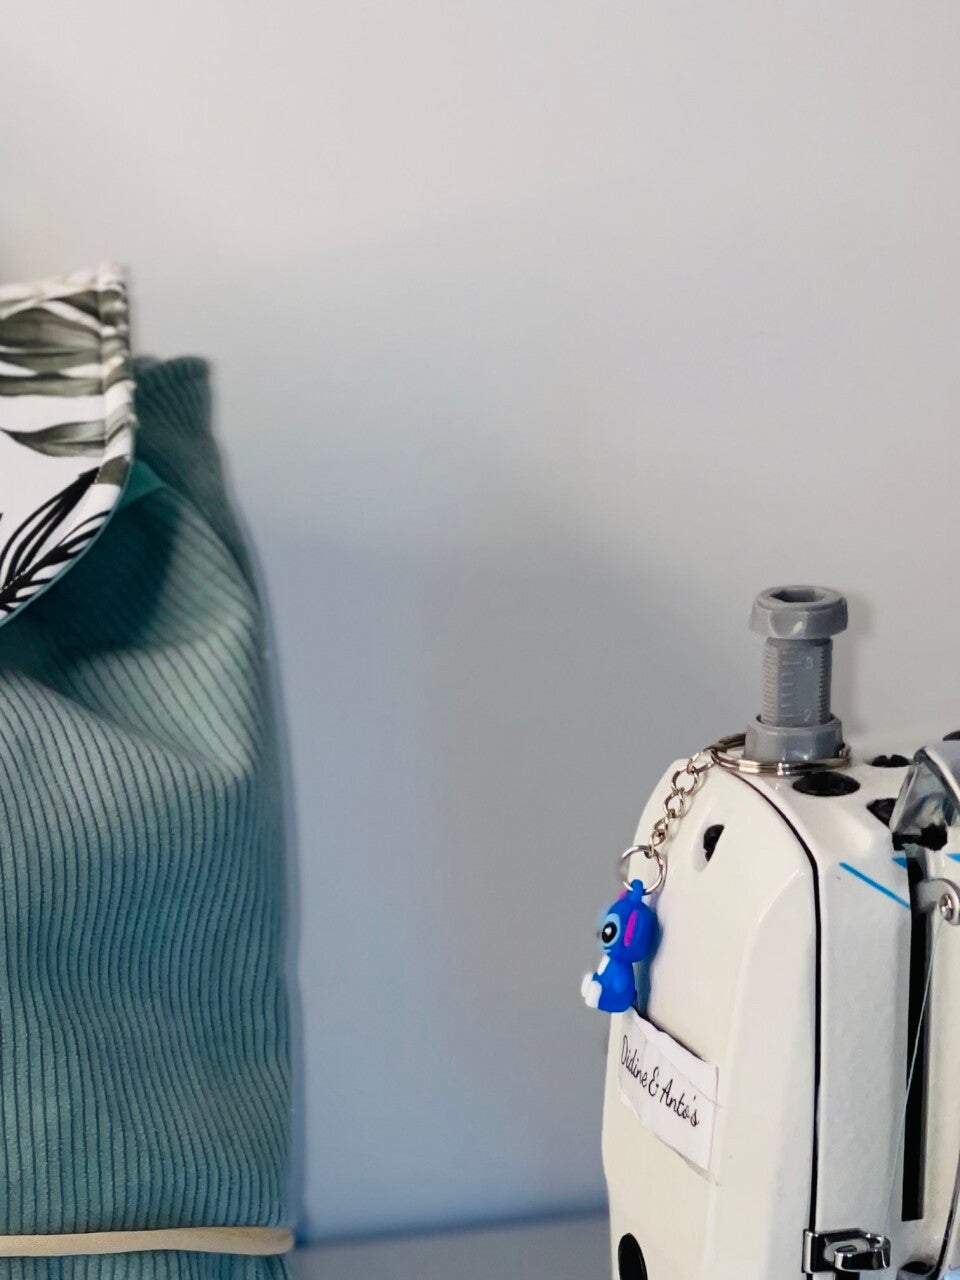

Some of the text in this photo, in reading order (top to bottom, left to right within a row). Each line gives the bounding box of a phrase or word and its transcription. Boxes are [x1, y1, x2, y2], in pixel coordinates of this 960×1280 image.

[620, 1035, 700, 1127] Didine & Anto's
